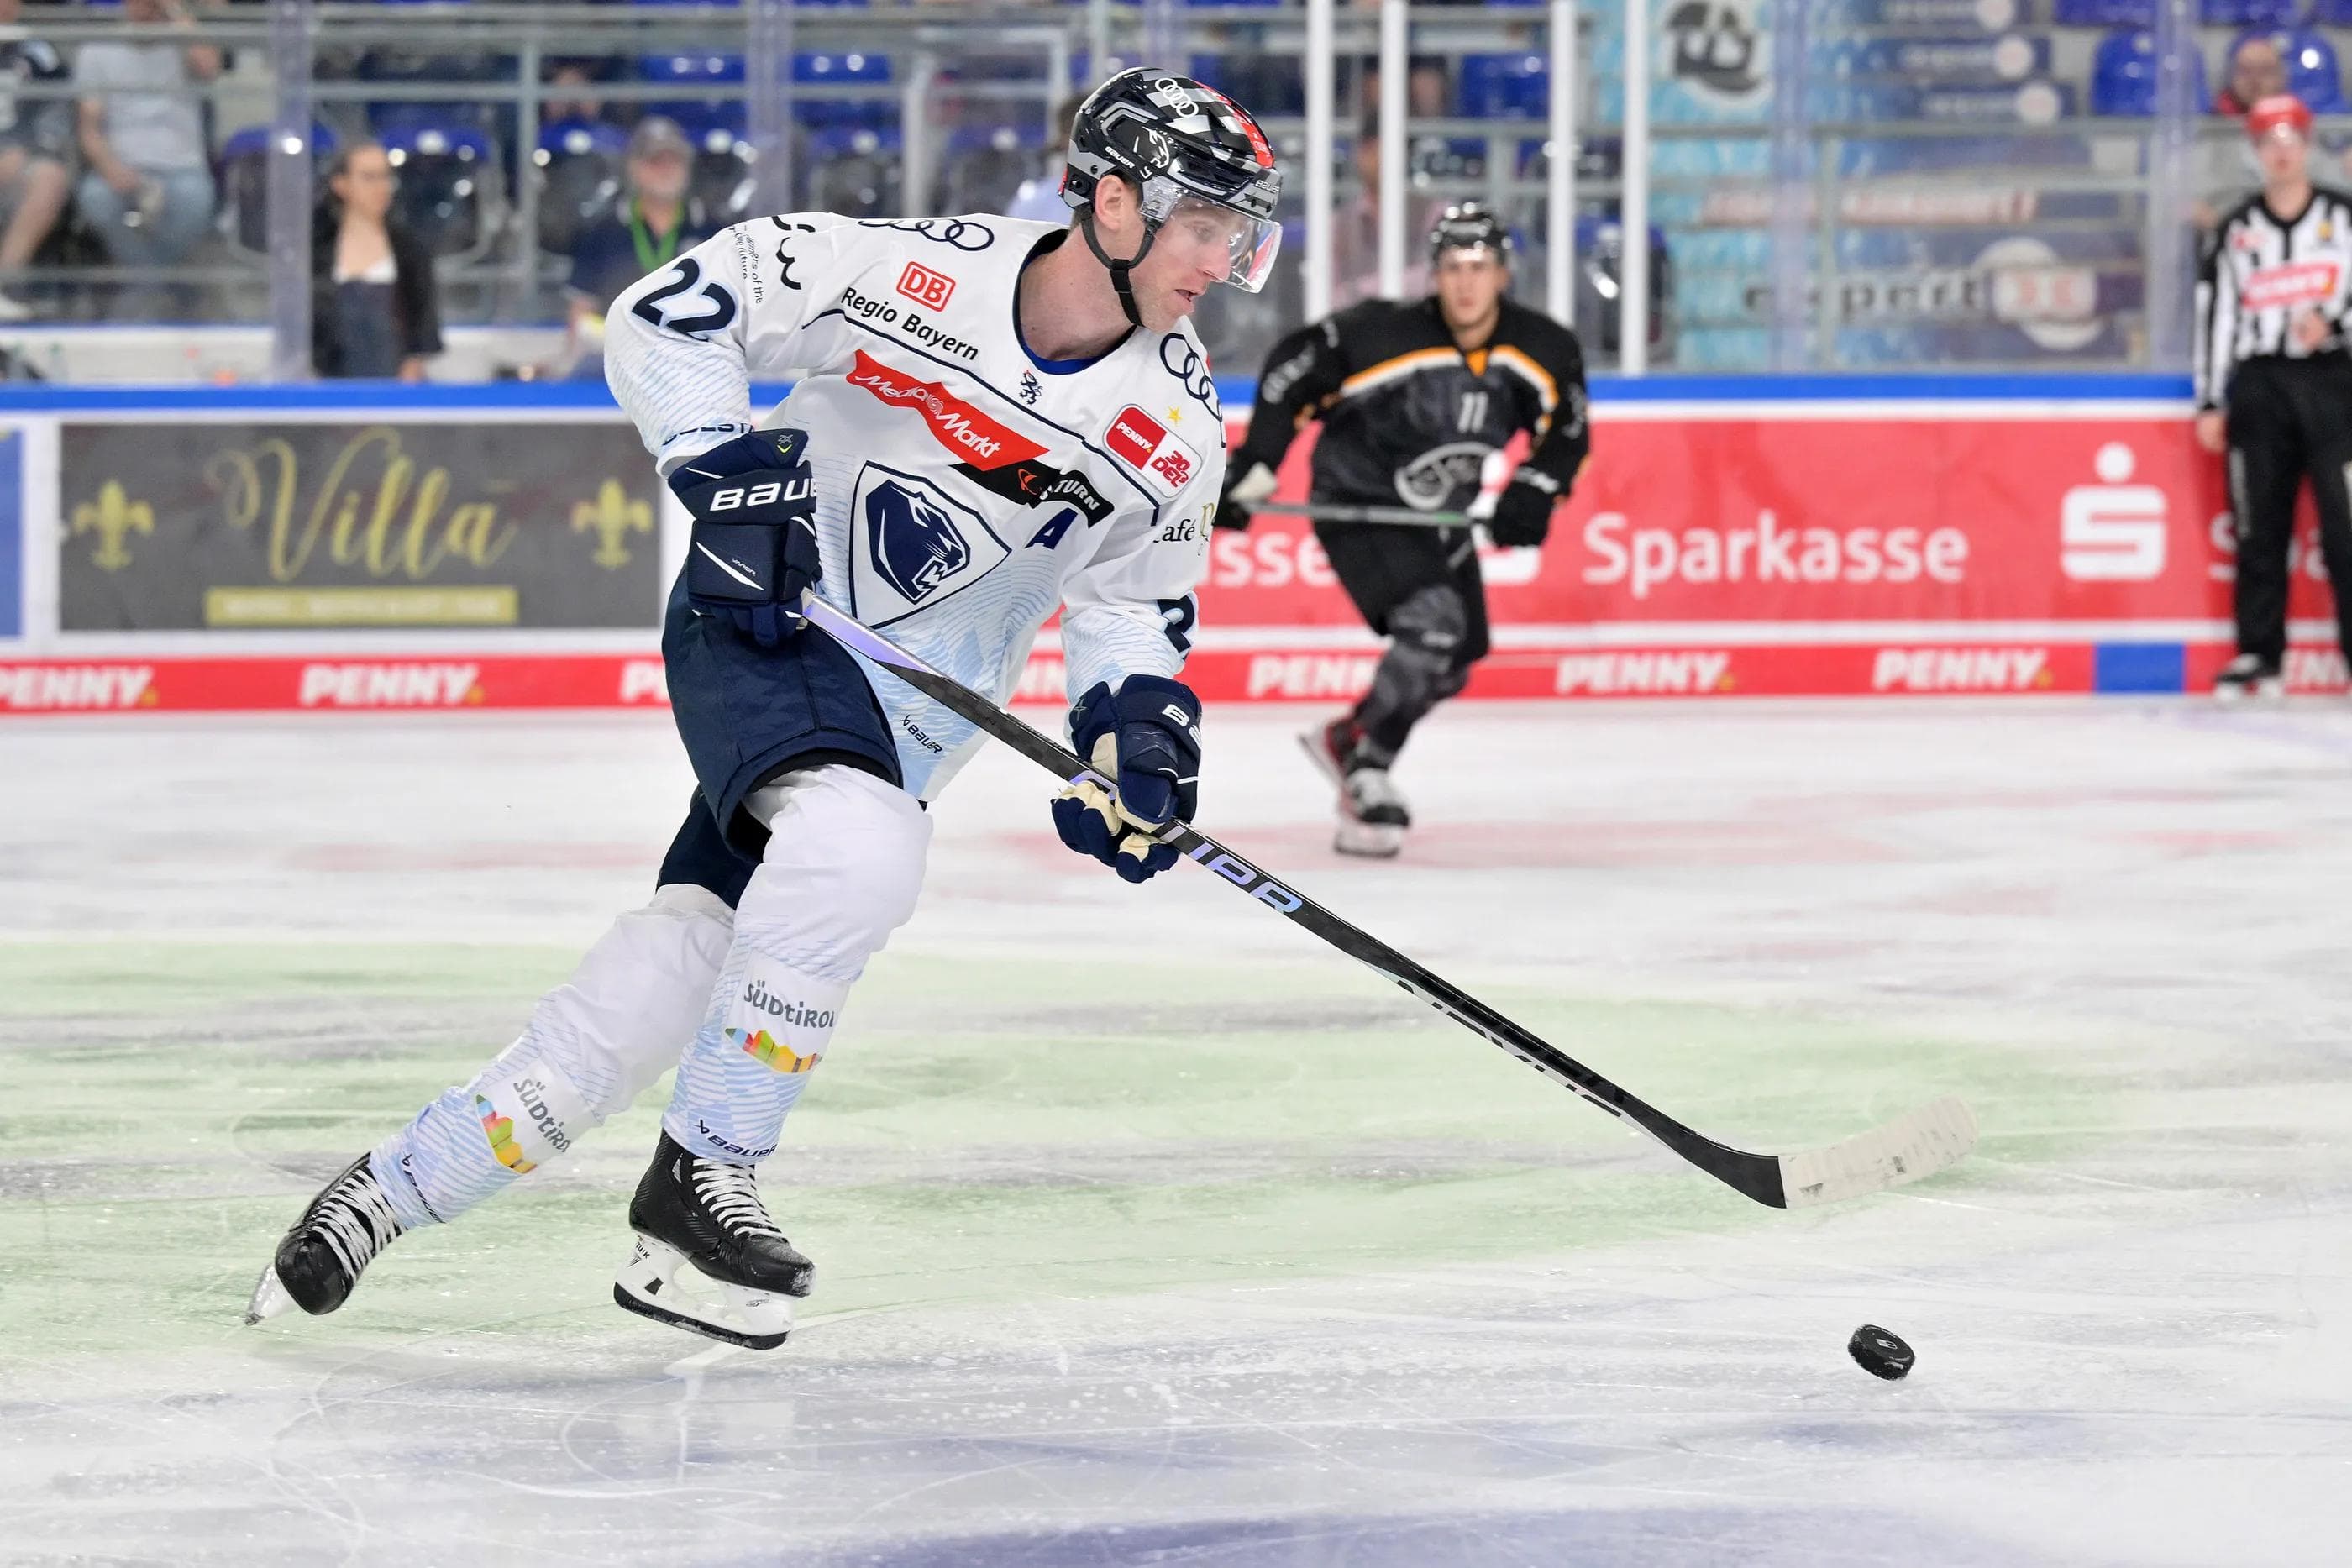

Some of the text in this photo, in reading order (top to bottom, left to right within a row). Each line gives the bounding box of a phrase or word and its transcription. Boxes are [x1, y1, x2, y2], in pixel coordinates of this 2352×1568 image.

[632, 257, 736, 342] 22
[841, 286, 979, 361] Regio Bayern
[903, 267, 948, 304] DB
[203, 426, 519, 581] Villa
[1023, 506, 1079, 551] A
[1582, 508, 1970, 600] Sparkasse
